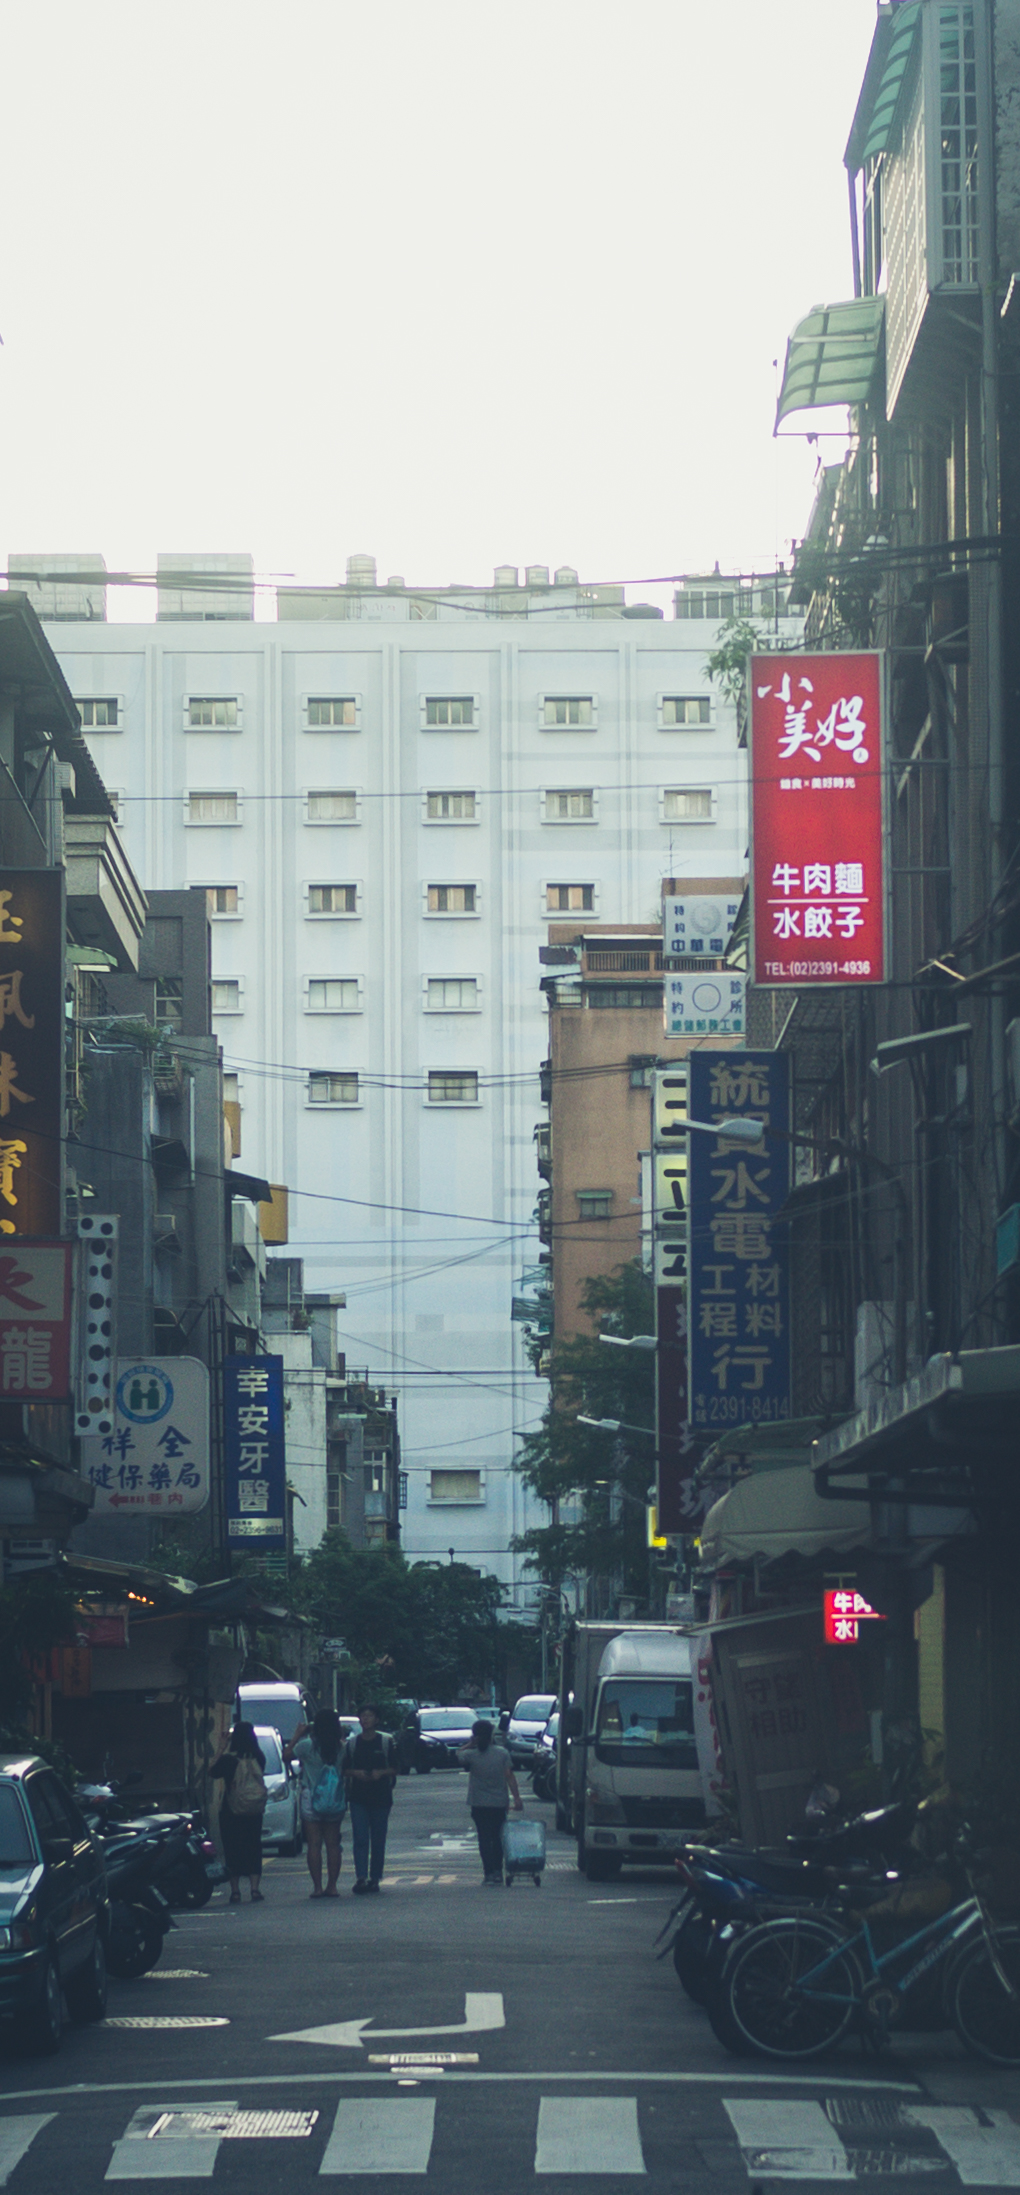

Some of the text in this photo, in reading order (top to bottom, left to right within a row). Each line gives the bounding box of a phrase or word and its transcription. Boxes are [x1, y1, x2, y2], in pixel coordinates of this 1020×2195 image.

[773, 906, 864, 939] 水餃子
[671, 981, 684, 1015] 特約
[730, 980, 743, 1014] 診所
[700, 1264, 738, 1339] 工程
[745, 1262, 784, 1338] 材料
[236, 1365, 270, 1513] 幸安牙醫
[88, 1462, 200, 1491] 健保藥局
[835, 1619, 859, 1640] 水
